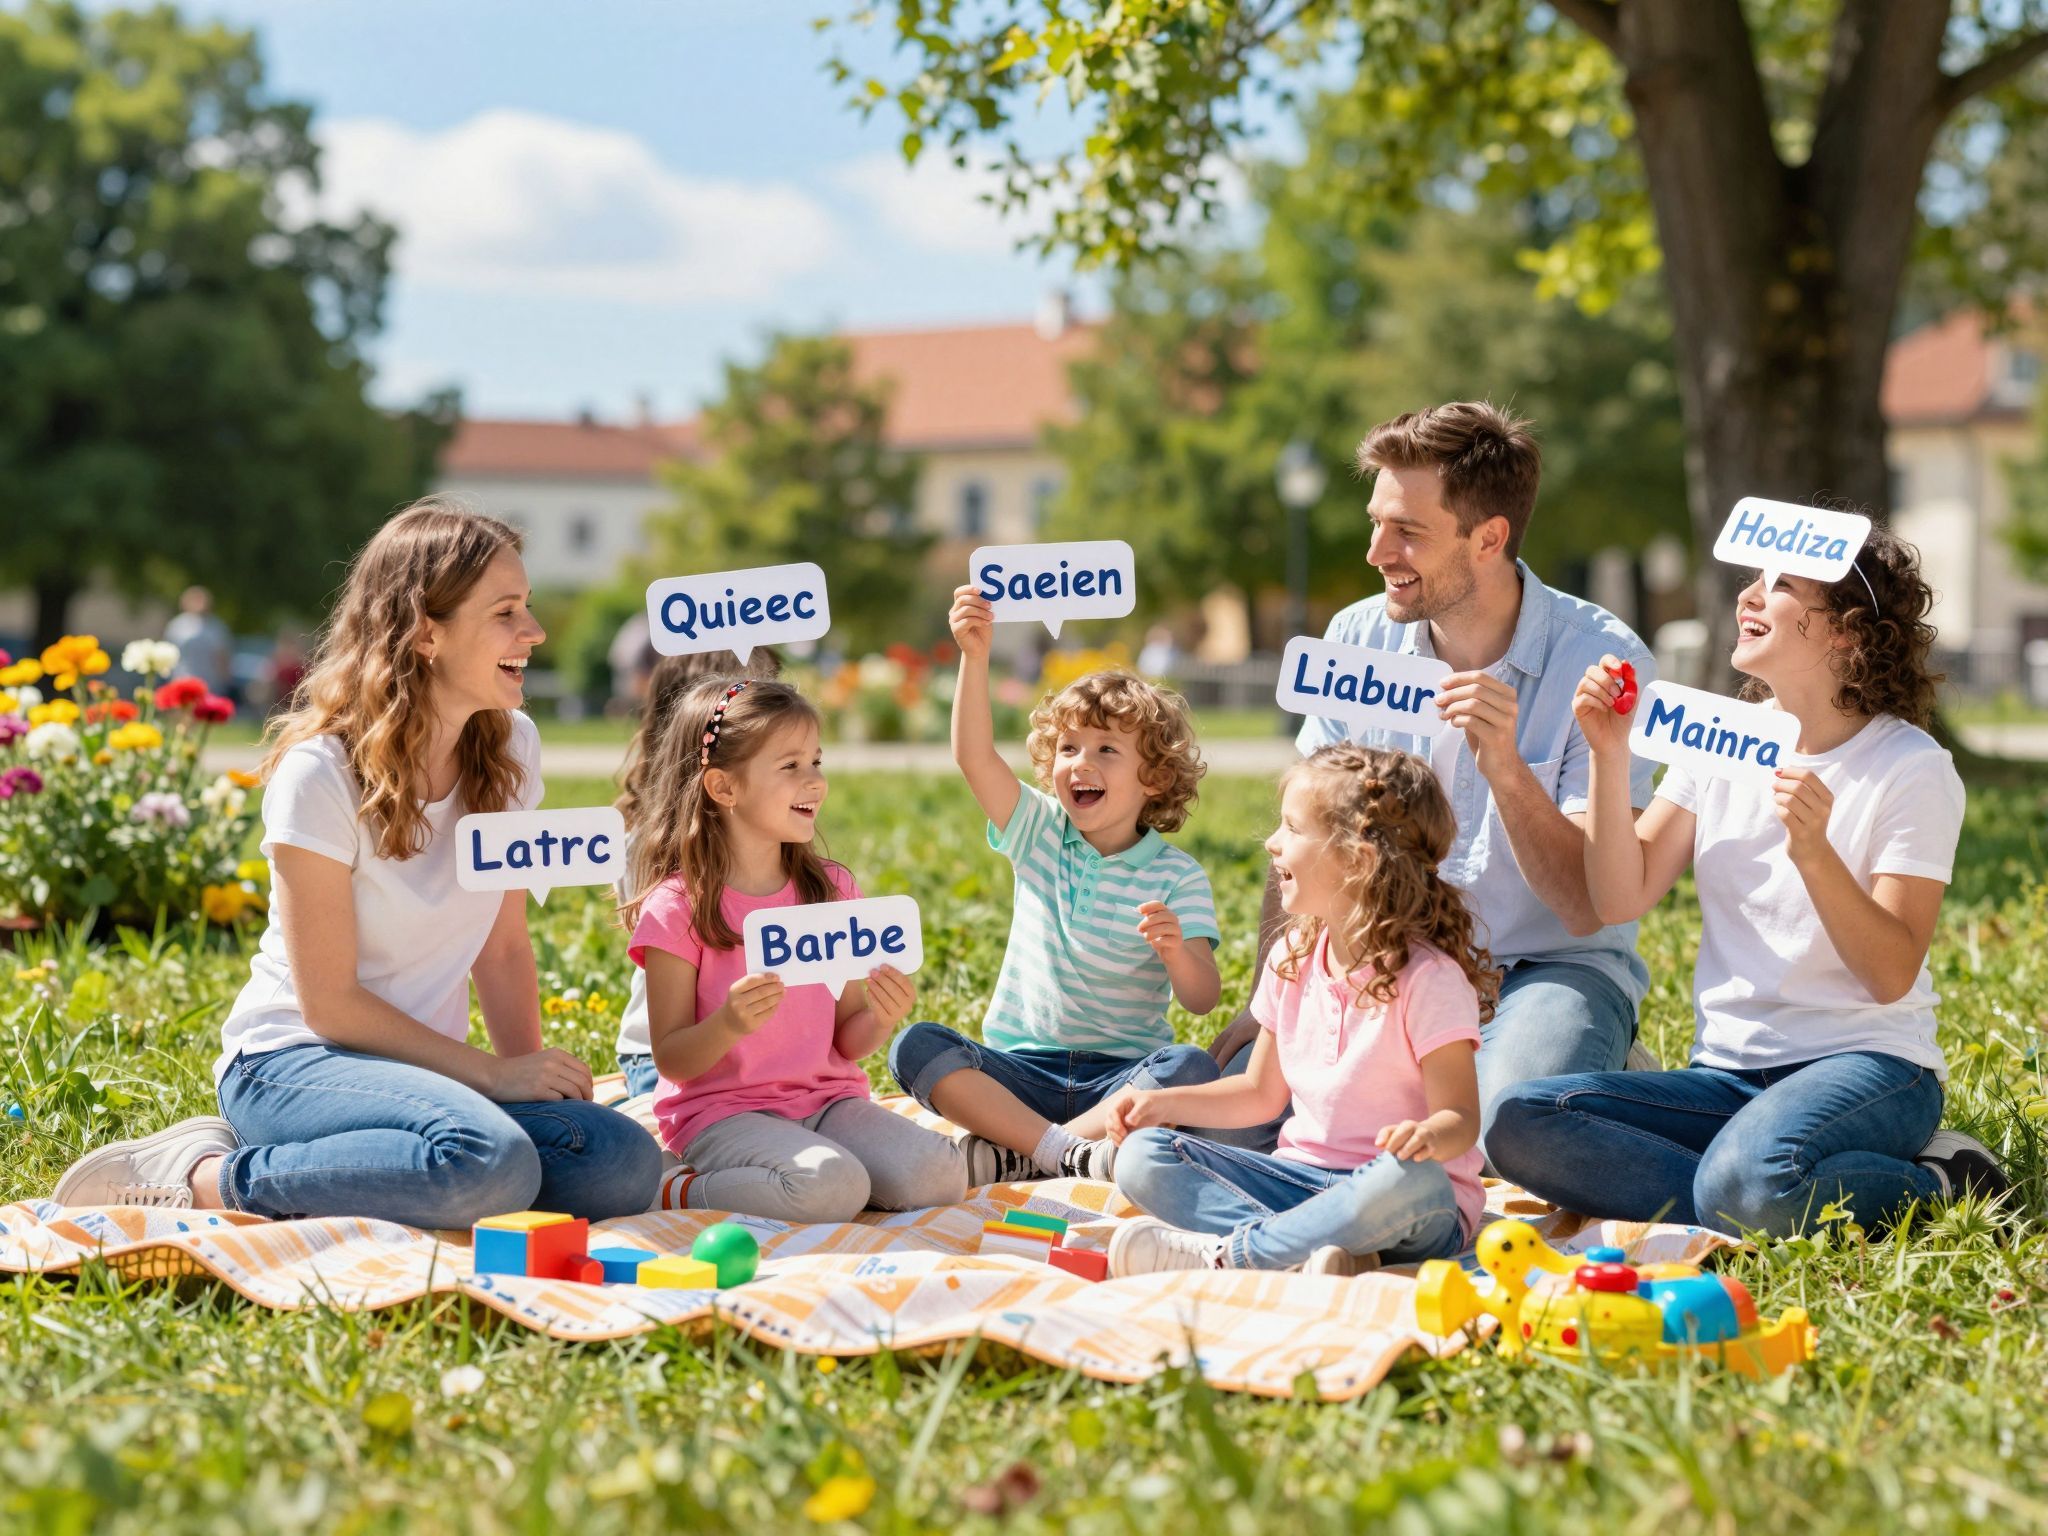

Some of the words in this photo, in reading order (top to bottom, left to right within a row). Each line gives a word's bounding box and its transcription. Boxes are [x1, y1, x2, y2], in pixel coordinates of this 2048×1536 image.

[1729, 510, 1849, 561] Hodiza
[979, 560, 1122, 602] Saeien
[660, 588, 816, 639] Quieec
[1292, 653, 1435, 714] Liabur
[1644, 698, 1780, 768] Mainra
[473, 830, 610, 870] Latrc
[761, 916, 906, 966] Barbe
